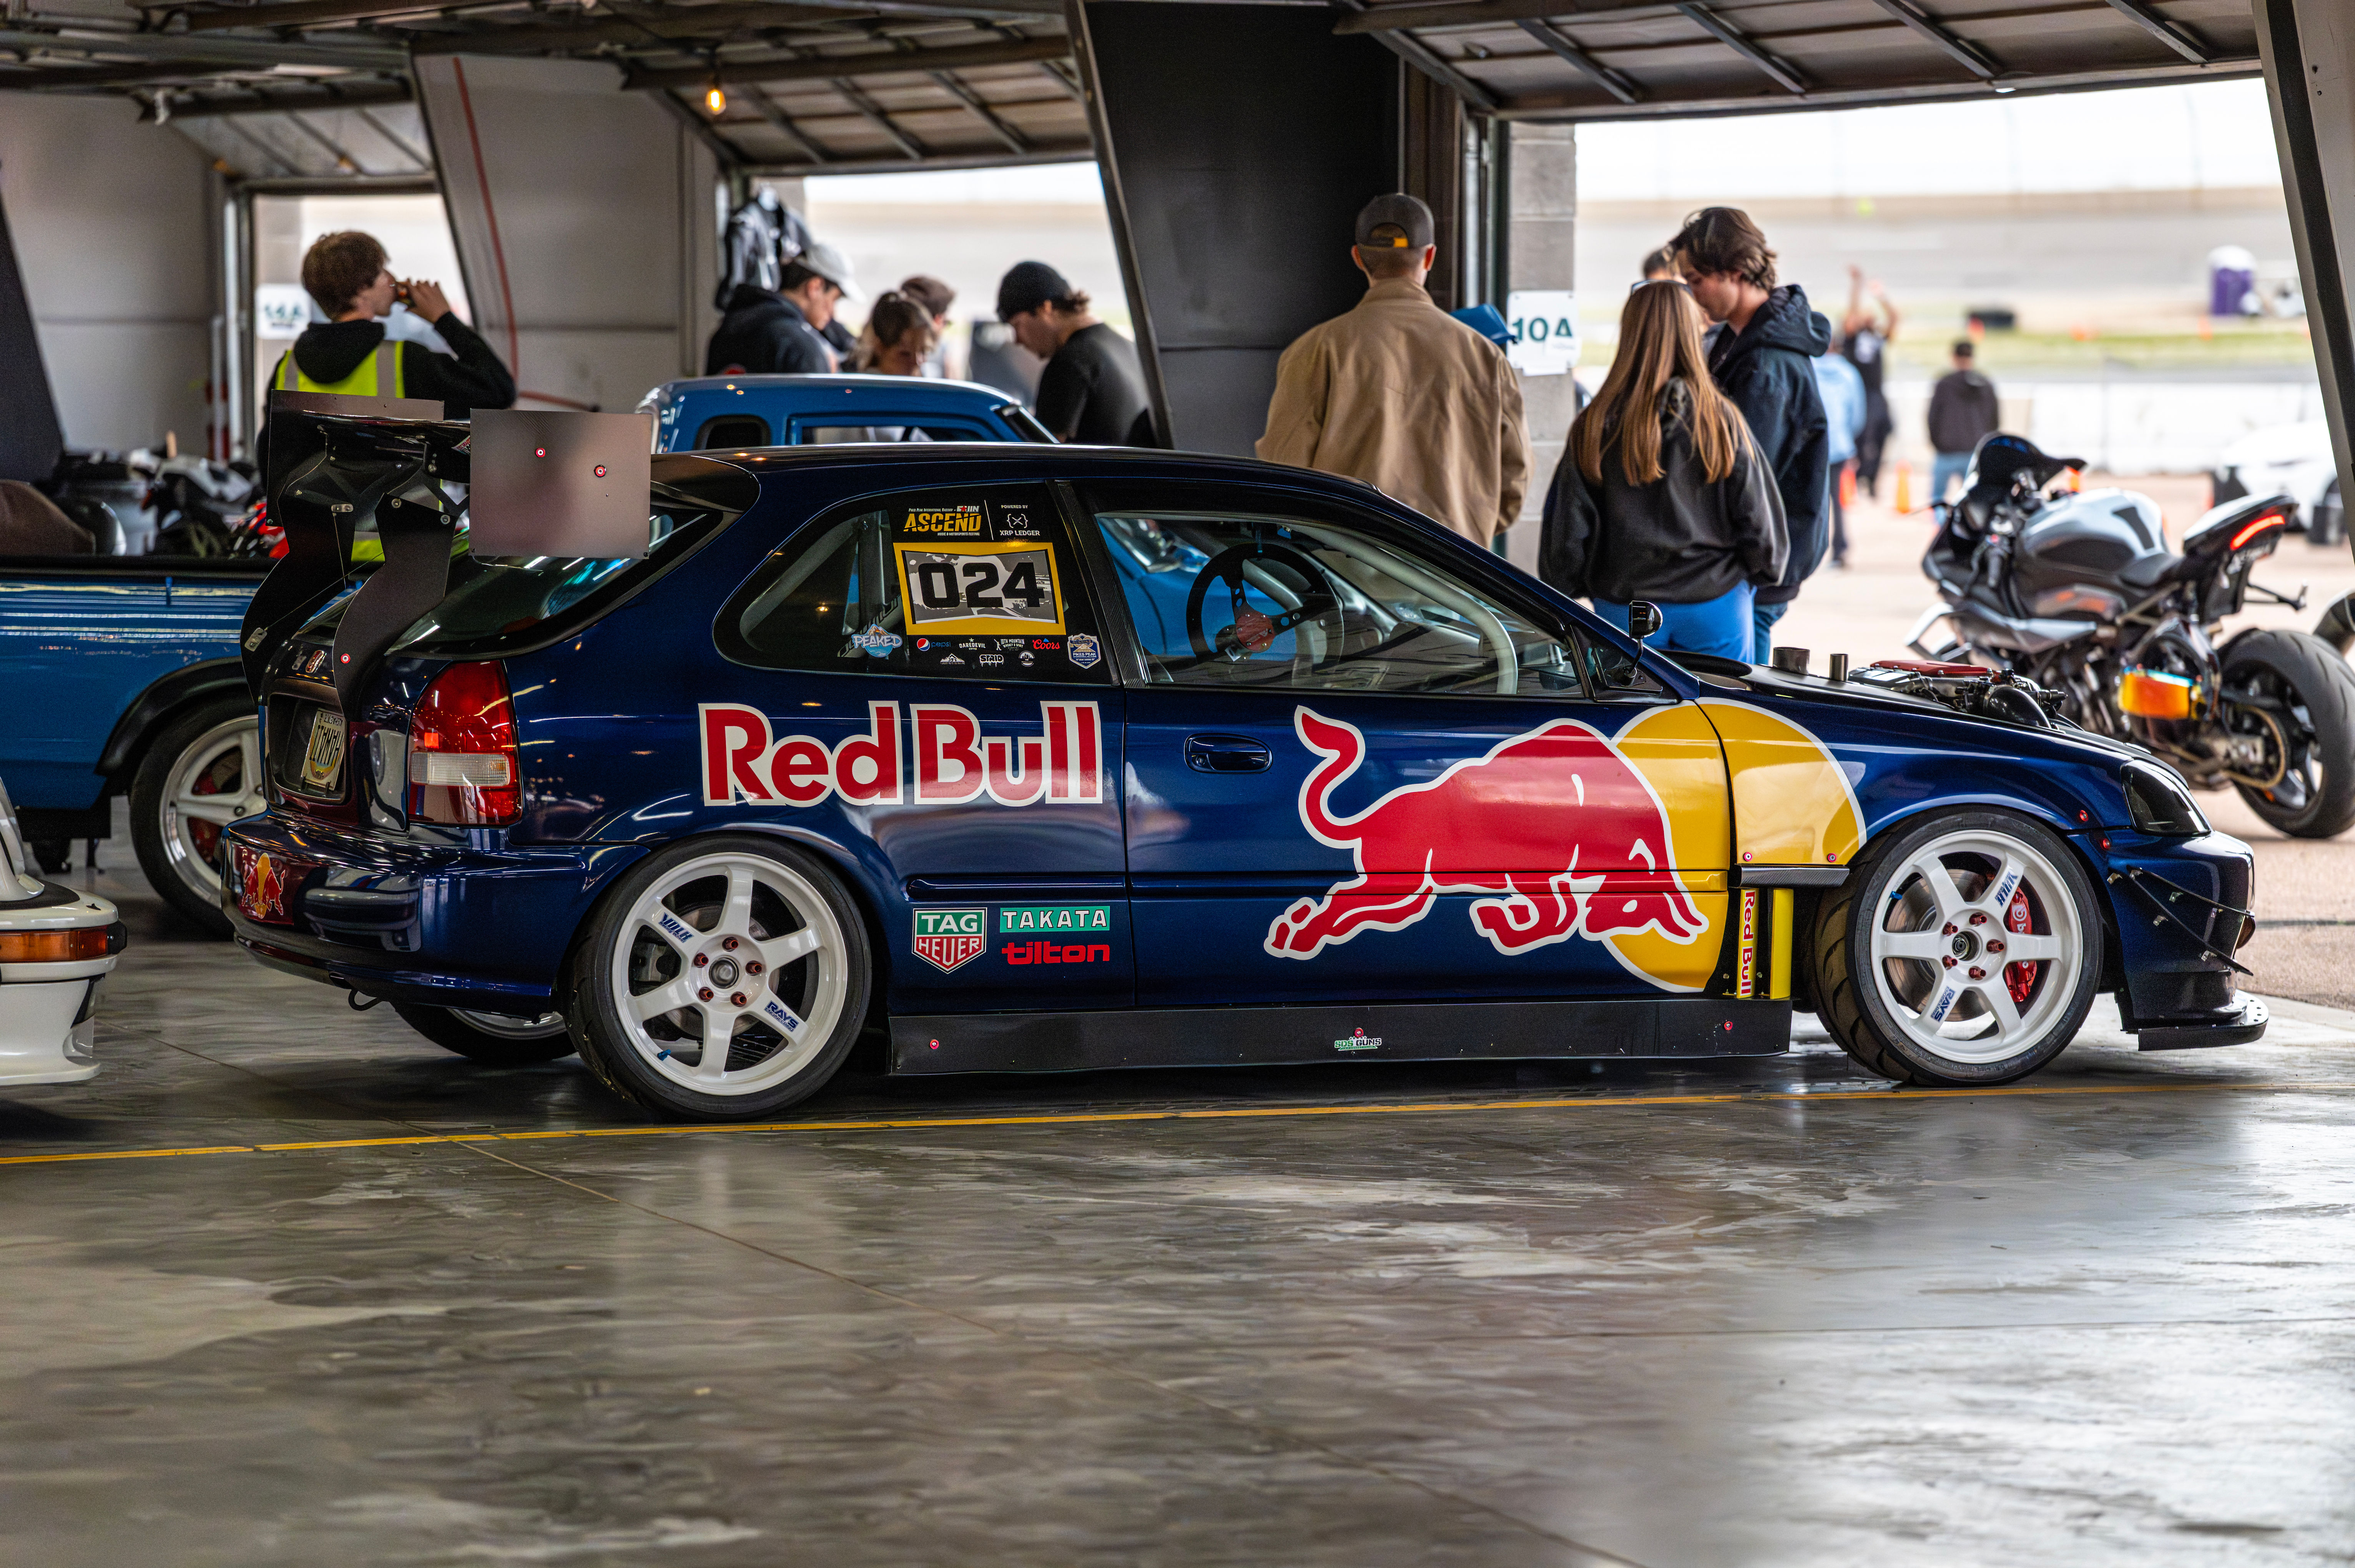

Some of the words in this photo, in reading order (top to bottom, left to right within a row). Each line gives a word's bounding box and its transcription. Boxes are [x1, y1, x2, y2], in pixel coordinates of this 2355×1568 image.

[903, 513, 981, 532] ASCEND
[917, 562, 1045, 608] 024
[853, 635, 902, 648] PEAKED
[1032, 639, 1060, 649] Coors
[698, 700, 903, 807] Red
[909, 701, 1102, 807] Bull
[921, 915, 978, 932] TAG
[1002, 910, 1107, 929] TAKATA
[1743, 890, 1755, 941] Red
[918, 938, 980, 965] HEUER
[1002, 941, 1110, 965] tilton
[1740, 946, 1753, 997] Bull
[767, 1001, 799, 1029] RAYS
[1934, 988, 1956, 1022] RAYS
[764, 1007, 794, 1032] ENGINEERING
[1335, 1040, 1353, 1048] SDS
[1356, 1038, 1382, 1046] GUNS
